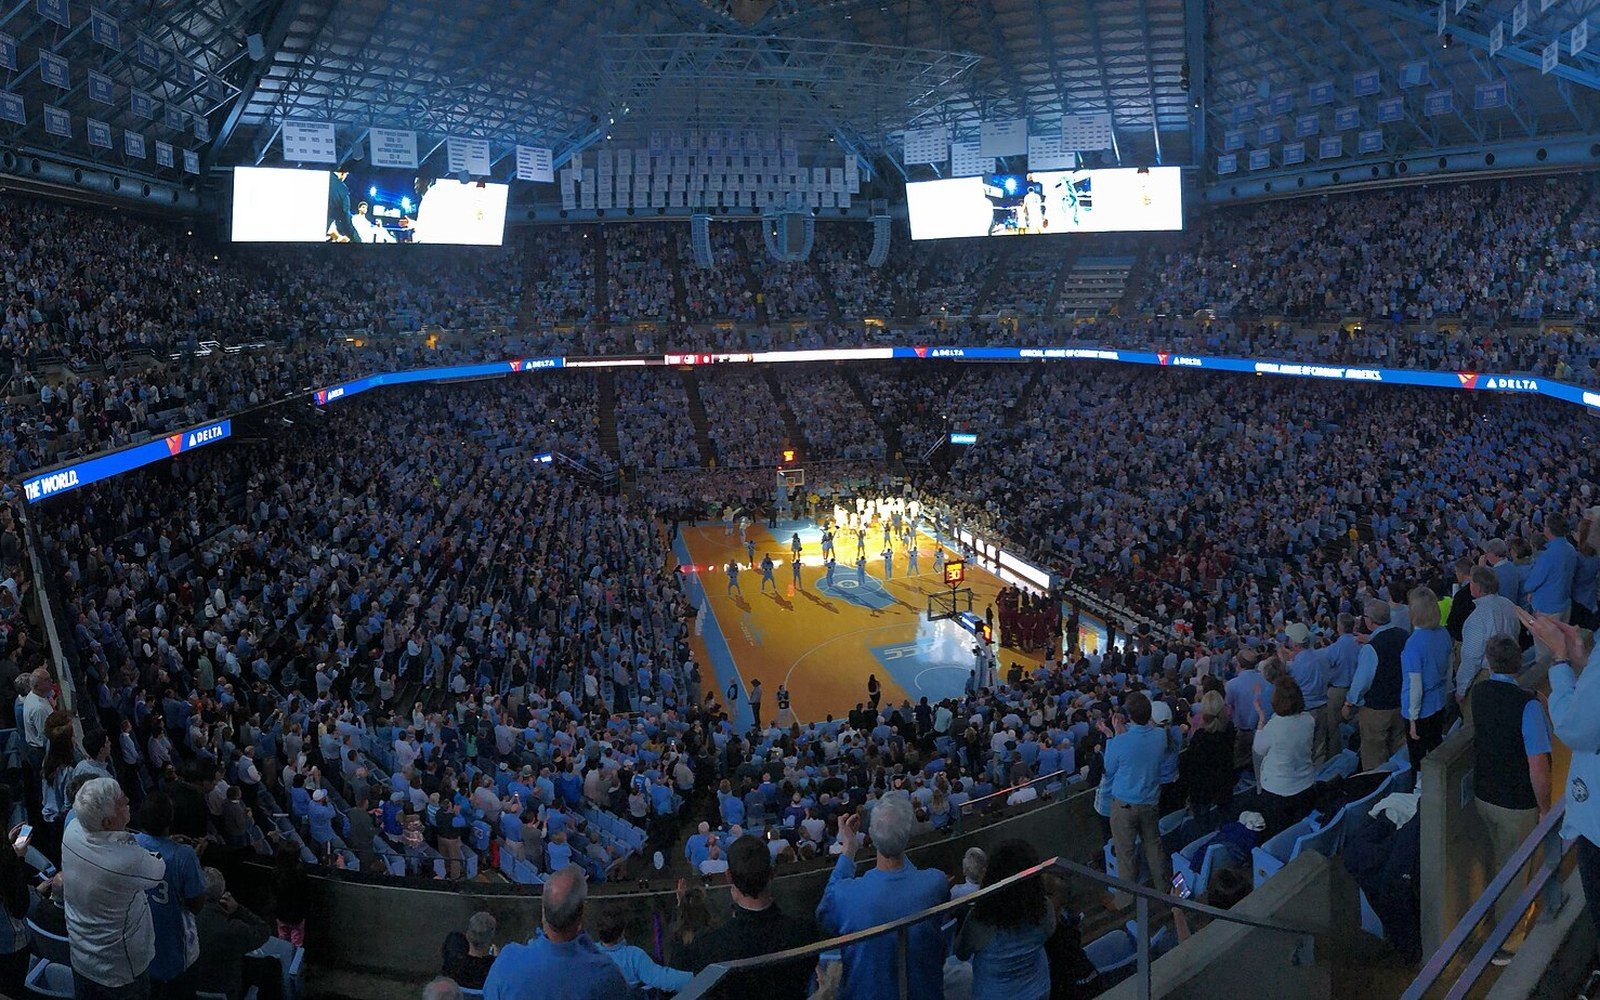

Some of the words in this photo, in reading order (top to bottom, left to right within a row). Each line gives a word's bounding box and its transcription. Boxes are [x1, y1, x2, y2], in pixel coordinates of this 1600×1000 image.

[939, 349, 964, 357] DELTA
[1499, 379, 1538, 390] DELTA
[196, 425, 223, 443] DELTA
[23, 480, 41, 500] THE
[41, 470, 80, 494] WORLD.
